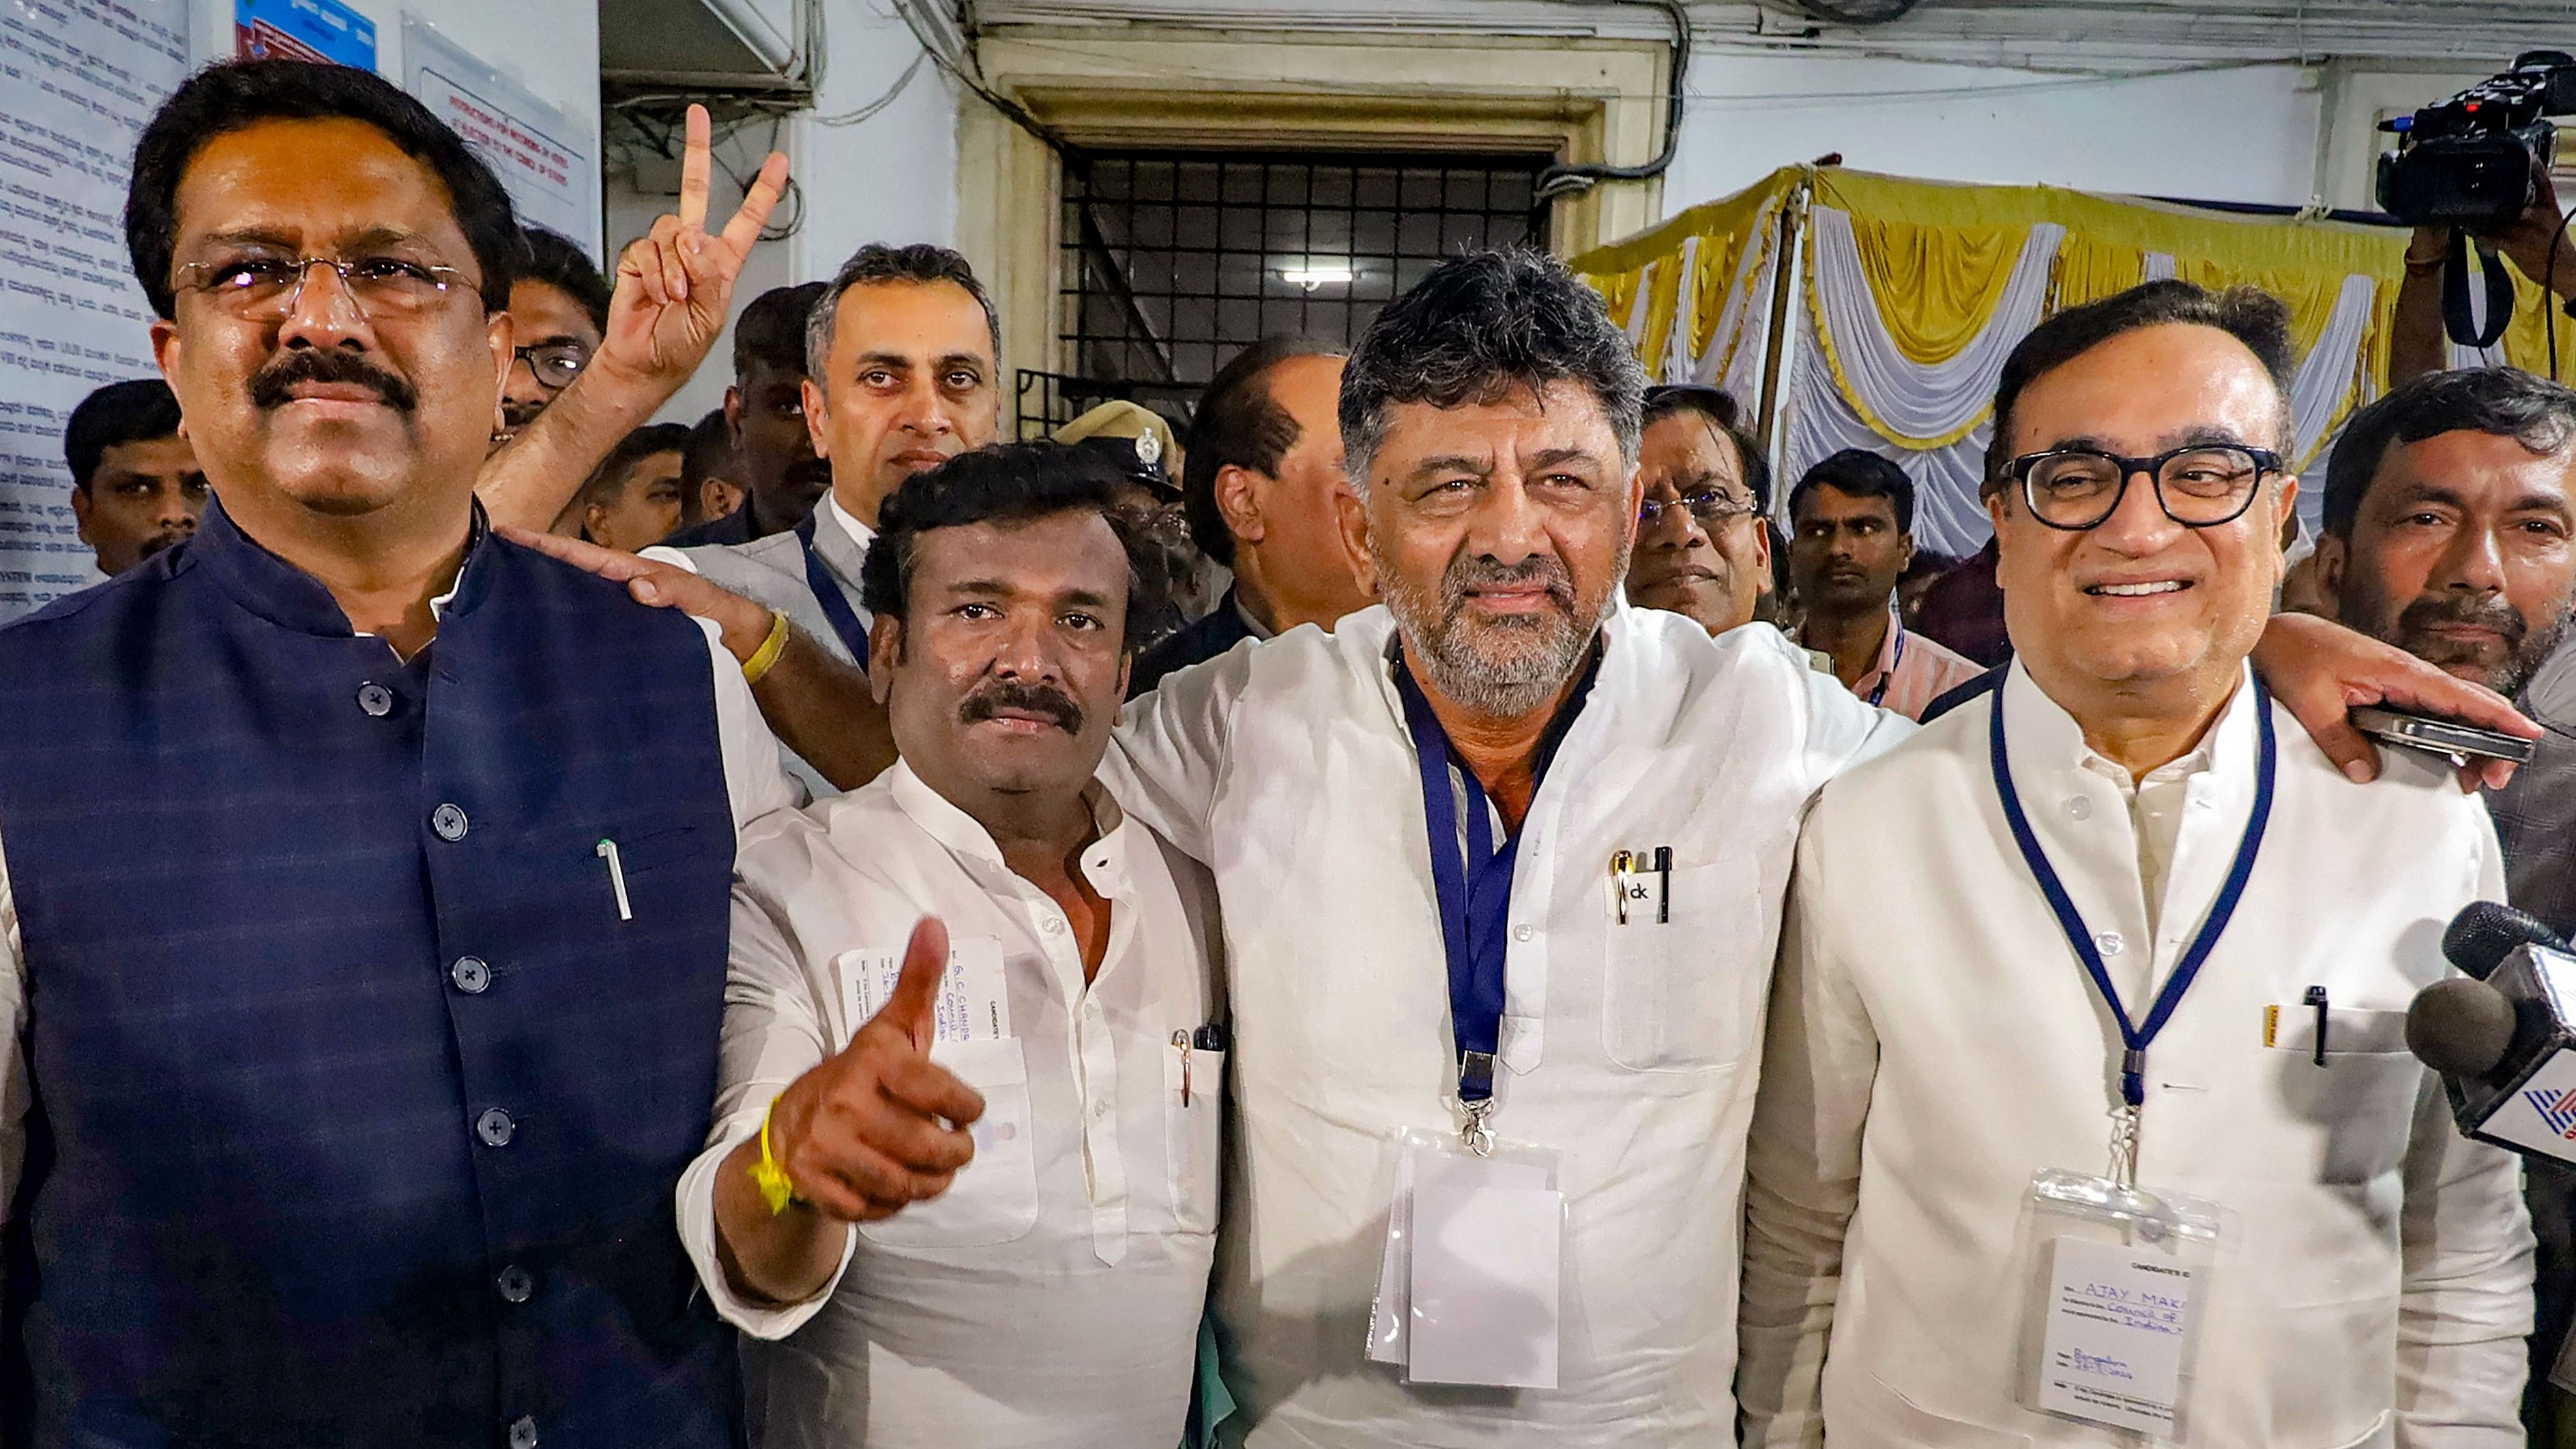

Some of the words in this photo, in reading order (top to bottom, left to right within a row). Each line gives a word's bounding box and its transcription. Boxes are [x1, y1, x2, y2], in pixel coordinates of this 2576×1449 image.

[1630, 883, 1648, 899] ck
[946, 992, 958, 1031] Council
[2085, 1283, 2129, 1300] AJAY
[2106, 1302, 2155, 1319] Council
